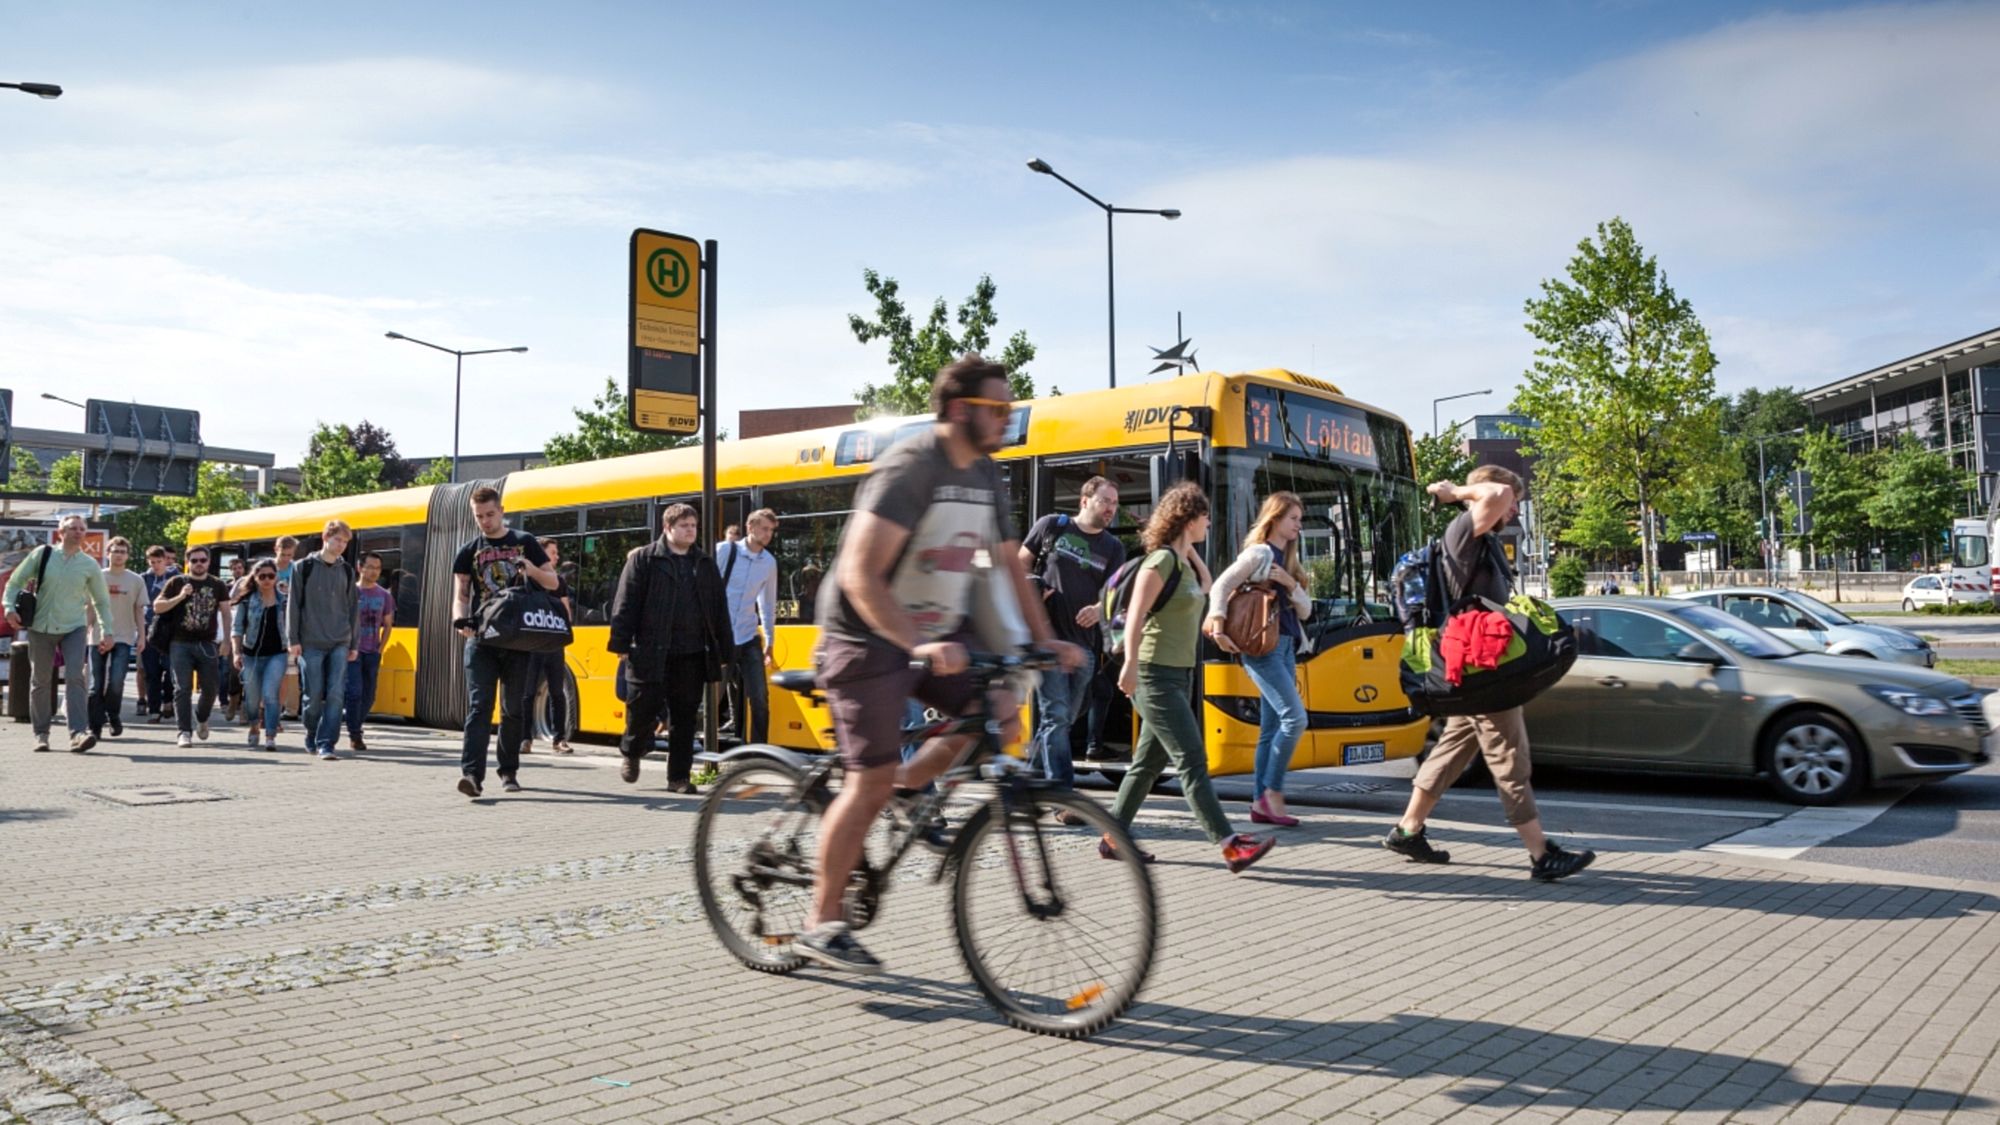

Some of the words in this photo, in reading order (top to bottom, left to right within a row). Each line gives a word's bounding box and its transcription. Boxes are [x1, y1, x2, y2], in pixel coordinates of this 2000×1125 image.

[657, 258, 679, 288] H
[677, 417, 696, 427] DVB
[1304, 413, 1372, 457] Löbtau
[85, 542, 100, 553] XI
